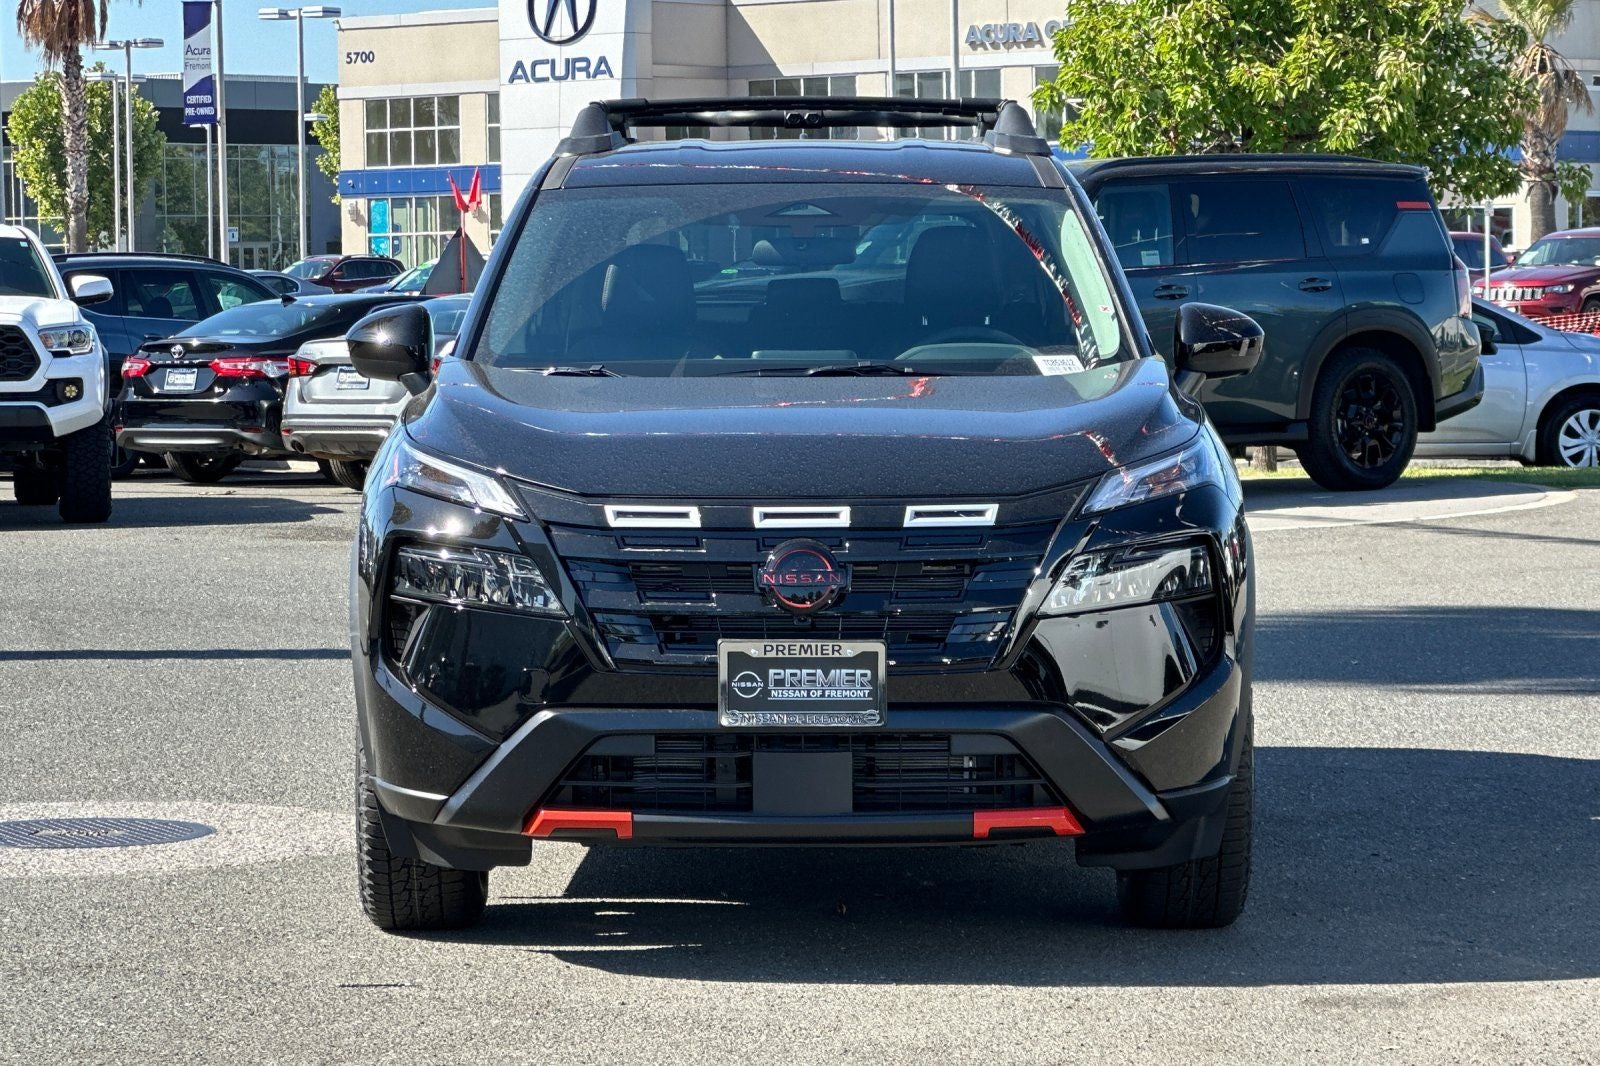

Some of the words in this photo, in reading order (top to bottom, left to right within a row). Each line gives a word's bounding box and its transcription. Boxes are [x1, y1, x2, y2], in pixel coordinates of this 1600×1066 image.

[965, 22, 1040, 43] ACURA
[185, 44, 211, 55] Acura
[346, 51, 375, 64] 5700
[508, 56, 614, 84] ACURA
[186, 95, 212, 105] CERTIFIED
[185, 107, 215, 117] PRE-OWNED
[763, 573, 842, 584] NISSAN
[763, 644, 842, 656] PREMIER
[768, 669, 872, 688] PREMIER
[771, 690, 807, 698] NISSAN
[810, 690, 823, 698] OF
[825, 690, 870, 698] FREMONT
[742, 713, 787, 724] NISSAN
